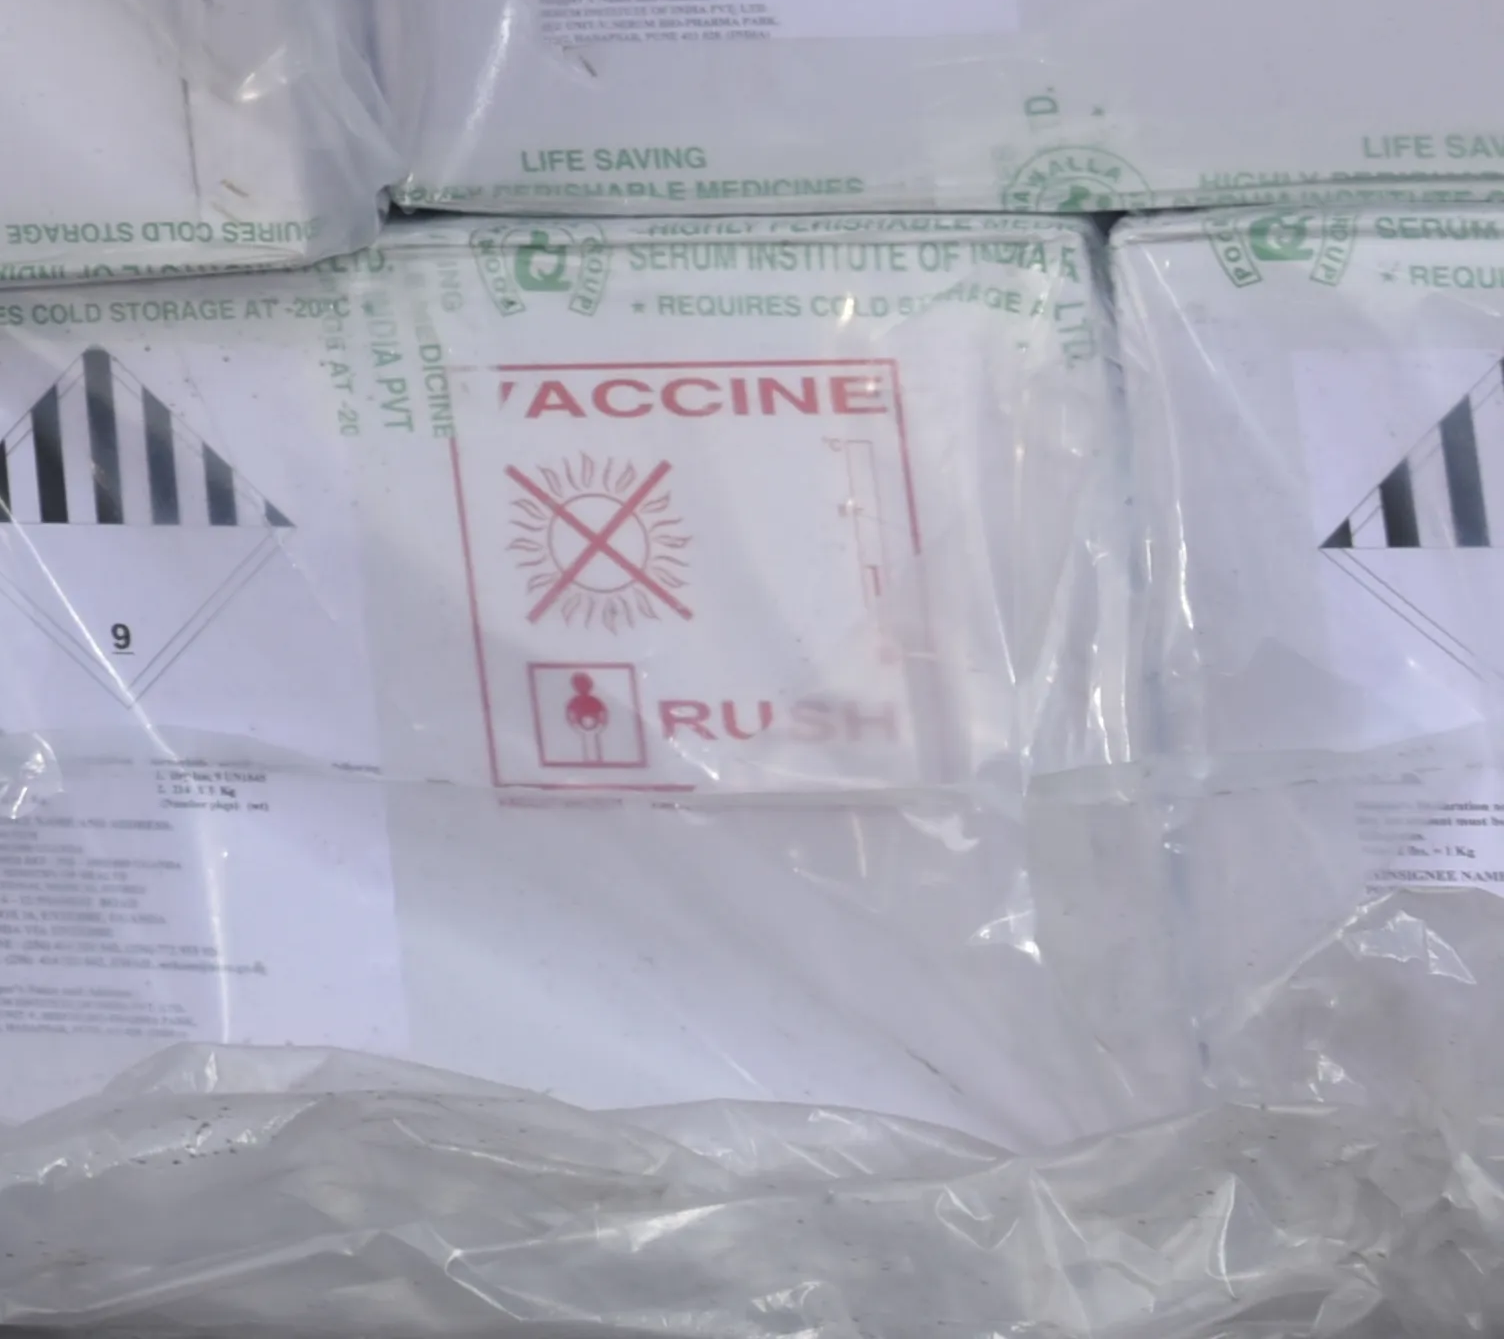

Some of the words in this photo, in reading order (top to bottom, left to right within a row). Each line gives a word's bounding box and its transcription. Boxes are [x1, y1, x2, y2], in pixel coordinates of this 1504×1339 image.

[522, 148, 589, 175] LIFE
[599, 145, 707, 174] SAVING
[110, 622, 133, 651] 9
